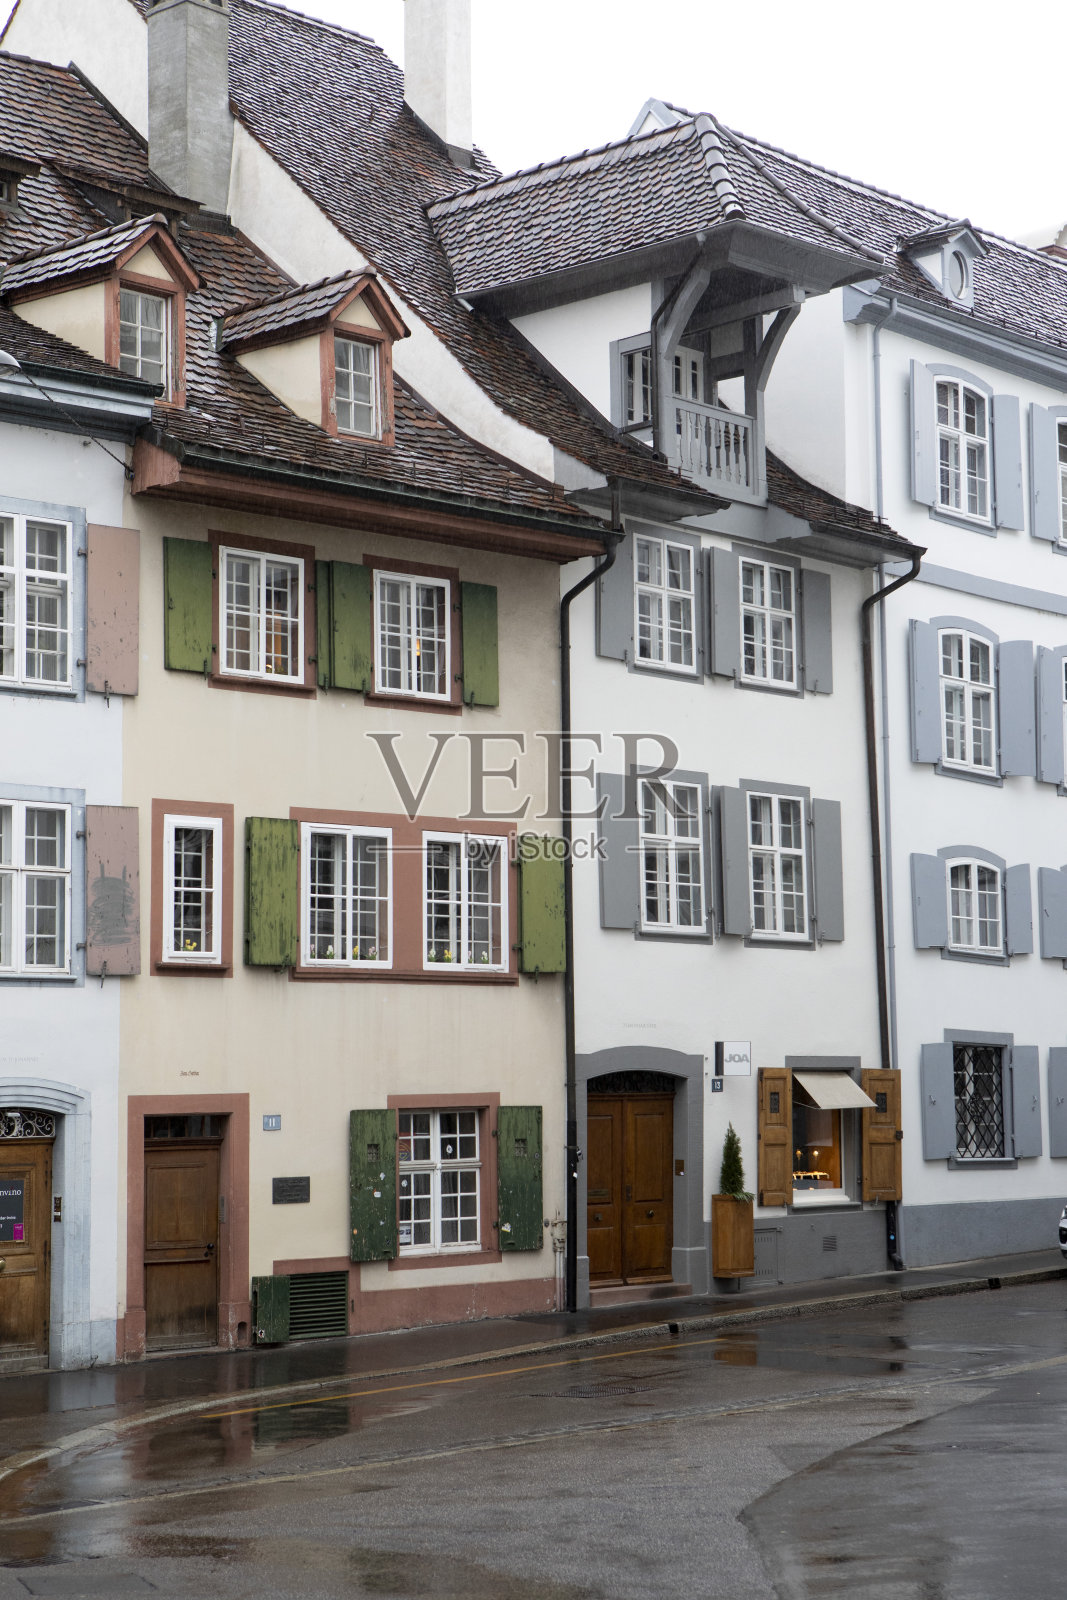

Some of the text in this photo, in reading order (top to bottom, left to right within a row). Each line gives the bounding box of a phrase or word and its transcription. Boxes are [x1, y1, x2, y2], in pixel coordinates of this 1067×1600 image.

[724, 1053, 750, 1062] JOA
[714, 1081, 721, 1090] 13
[268, 1117, 276, 1128] 11
